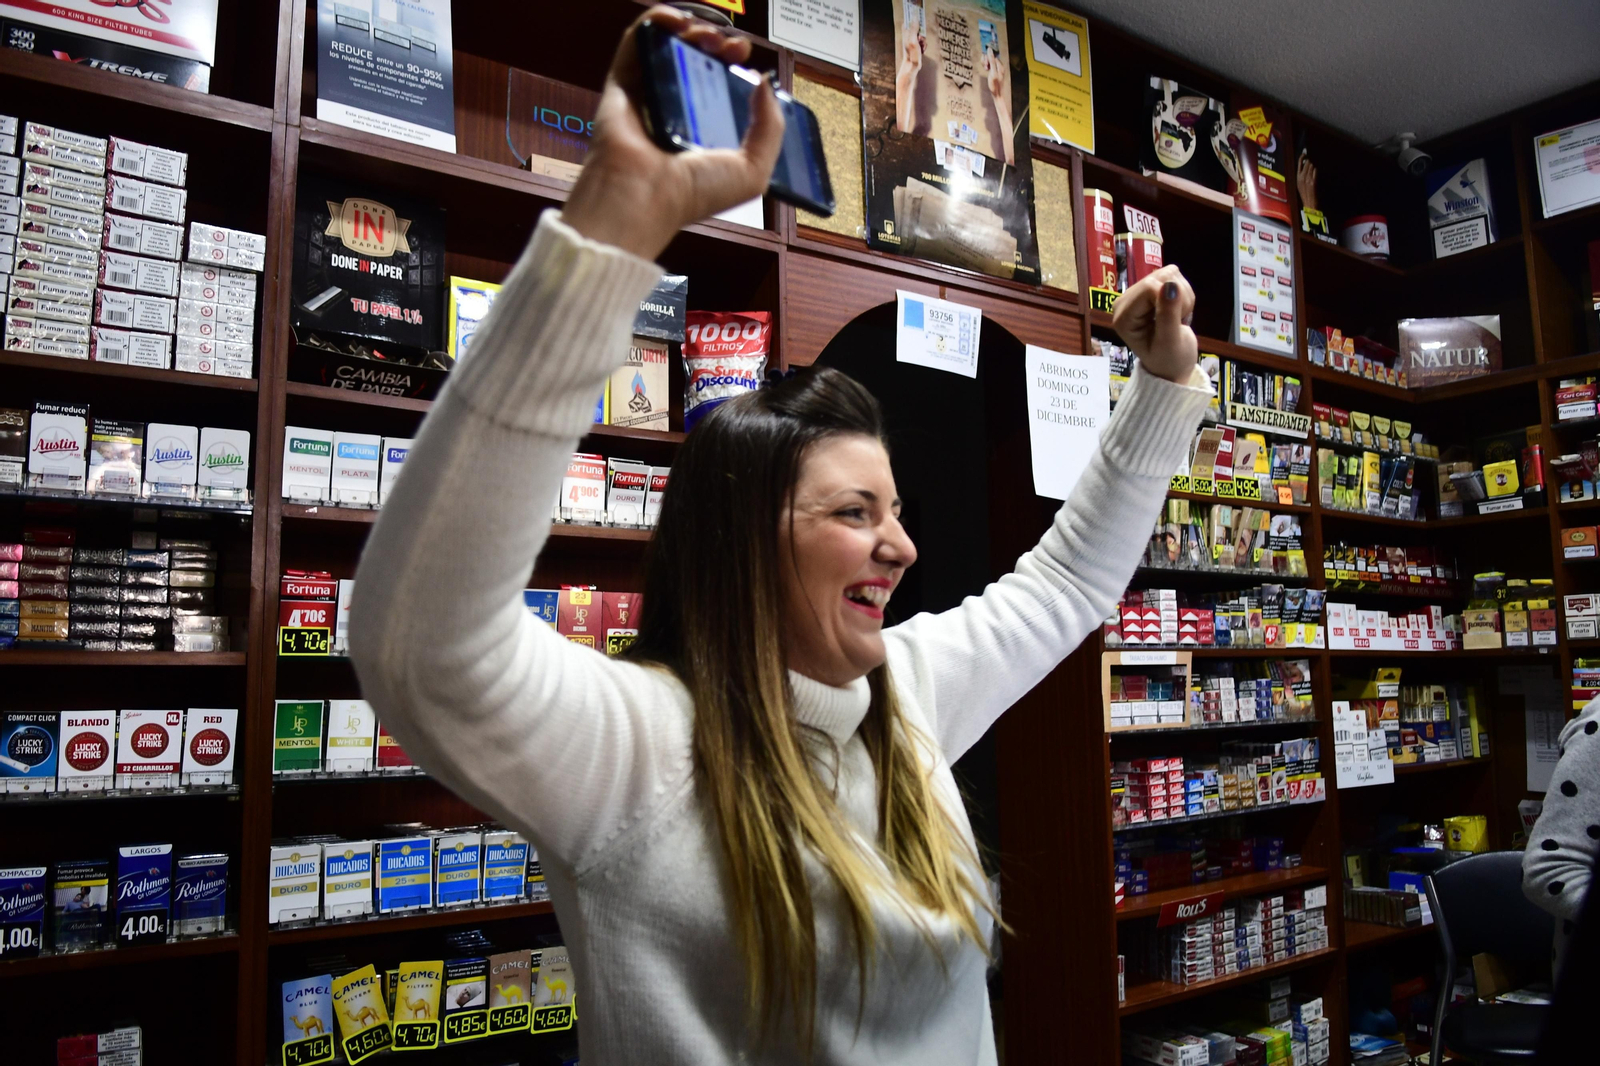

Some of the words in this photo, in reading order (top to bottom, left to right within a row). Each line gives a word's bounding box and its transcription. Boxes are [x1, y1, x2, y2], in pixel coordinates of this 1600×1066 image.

[1023, 5, 1040, 15] ZONA
[52, 8, 66, 16] 600
[67, 10, 85, 21] KING
[87, 15, 103, 25] SIZE
[104, 18, 128, 31] FILTER
[130, 25, 153, 38] TUBES
[10, 28, 35, 41] 300
[9, 39, 35, 50] +50
[331, 41, 373, 60] REDUCE
[376, 56, 394, 67] entre
[407, 63, 442, 81] 90-95%
[329, 51, 339, 59] los
[341, 54, 365, 67] niveles
[376, 64, 418, 82] componentes
[421, 76, 444, 90] dañinos
[57, 132, 81, 143] Fumar
[353, 202, 387, 215] DONE
[1444, 197, 1479, 212] Winston
[53, 209, 78, 220] Fumar
[353, 209, 385, 245] IN
[1127, 209, 1158, 236] 7,50€
[351, 239, 386, 252] PAPER
[41, 303, 65, 314] Fumar
[351, 298, 368, 313] TU
[371, 301, 403, 320] PAPEL
[640, 301, 675, 317] GORILLA
[929, 309, 954, 322] 93756
[687, 321, 762, 344] 1000
[37, 342, 62, 352] Fumar
[703, 341, 743, 352] FILTROS
[1410, 347, 1490, 369] NATUR
[336, 365, 412, 388] CAMBIA
[1039, 362, 1089, 380] ABRIMOS
[1037, 377, 1089, 396] DOMINGO
[36, 402, 60, 411] Fumar
[61, 404, 86, 414] reduce
[1050, 396, 1061, 407] 23
[1063, 399, 1078, 411] DE
[1560, 406, 1579, 414] Fumar
[1036, 409, 1096, 428] DICIEMBRE
[1240, 407, 1308, 432] AMSTERDAMER
[32, 438, 80, 454] Austin
[293, 440, 329, 452] Fortuna
[341, 445, 375, 456] Fortuna
[149, 448, 193, 463] Austin
[201, 453, 244, 469] Austin
[289, 465, 324, 475] MENTOL
[341, 470, 369, 478] PLATA
[567, 463, 604, 475] Fortuna
[615, 473, 646, 483] Fortuna
[286, 584, 330, 595] Fortuna
[284, 632, 327, 651] 4,70€
[1354, 639, 1370, 647] REIG
[1404, 640, 1418, 649] REIG
[1432, 641, 1446, 649] REIG
[1134, 703, 1156, 711] HEETS
[1160, 702, 1182, 710] HEETS
[8, 714, 38, 722] COMPACT
[38, 714, 56, 722] CLICK
[67, 719, 109, 727] BLANDO
[167, 713, 179, 724] XL
[203, 716, 223, 724] RED
[18, 739, 43, 748] LUCKY
[137, 740, 162, 748] STRIKE
[139, 733, 162, 742] LUCKY
[199, 739, 223, 748] LUCKY
[279, 739, 316, 747] MENTOL
[336, 738, 365, 746] WHITE
[15, 746, 43, 755] STRIKE
[75, 743, 101, 752] LUCKY
[196, 746, 223, 755] STRIKE
[72, 751, 102, 760] STRIKE
[132, 764, 174, 772] CIGARRILLOS
[130, 847, 162, 855] LARGOS
[489, 849, 524, 863] DUCADOS
[387, 854, 425, 870] DUCADOS
[442, 851, 477, 866] DUCADOS
[275, 862, 315, 878] DUCADOS
[329, 858, 369, 874] DUCADOS
[488, 867, 521, 877] BLANDO
[0, 869, 42, 878] OMPACTO
[57, 873, 79, 881] embolias
[446, 871, 470, 881] DURO
[119, 876, 170, 900] Rothmans
[145, 886, 163, 897] LONDON
[175, 878, 226, 902] Rothmans
[280, 884, 308, 894] DURO
[334, 881, 362, 891] DURO
[0, 891, 44, 913] othmans
[16, 902, 37, 915] LONDON
[121, 915, 164, 940] 4,00€
[0, 927, 38, 955] ,00€
[492, 960, 530, 975] CAMEL
[400, 970, 440, 983] CAMEL
[285, 986, 330, 1003] CAMEL
[333, 976, 376, 1001] CAMEL
[343, 989, 371, 1004] FILTERS
[299, 1000, 318, 1008] BLUE
[492, 1008, 528, 1028] 4,60€
[535, 1009, 570, 1028] 4,60€
[448, 1015, 486, 1036] 4,85€
[349, 1028, 390, 1054] 4,60€
[397, 1026, 435, 1045] 4,70€
[288, 1039, 330, 1063] 4,70€
